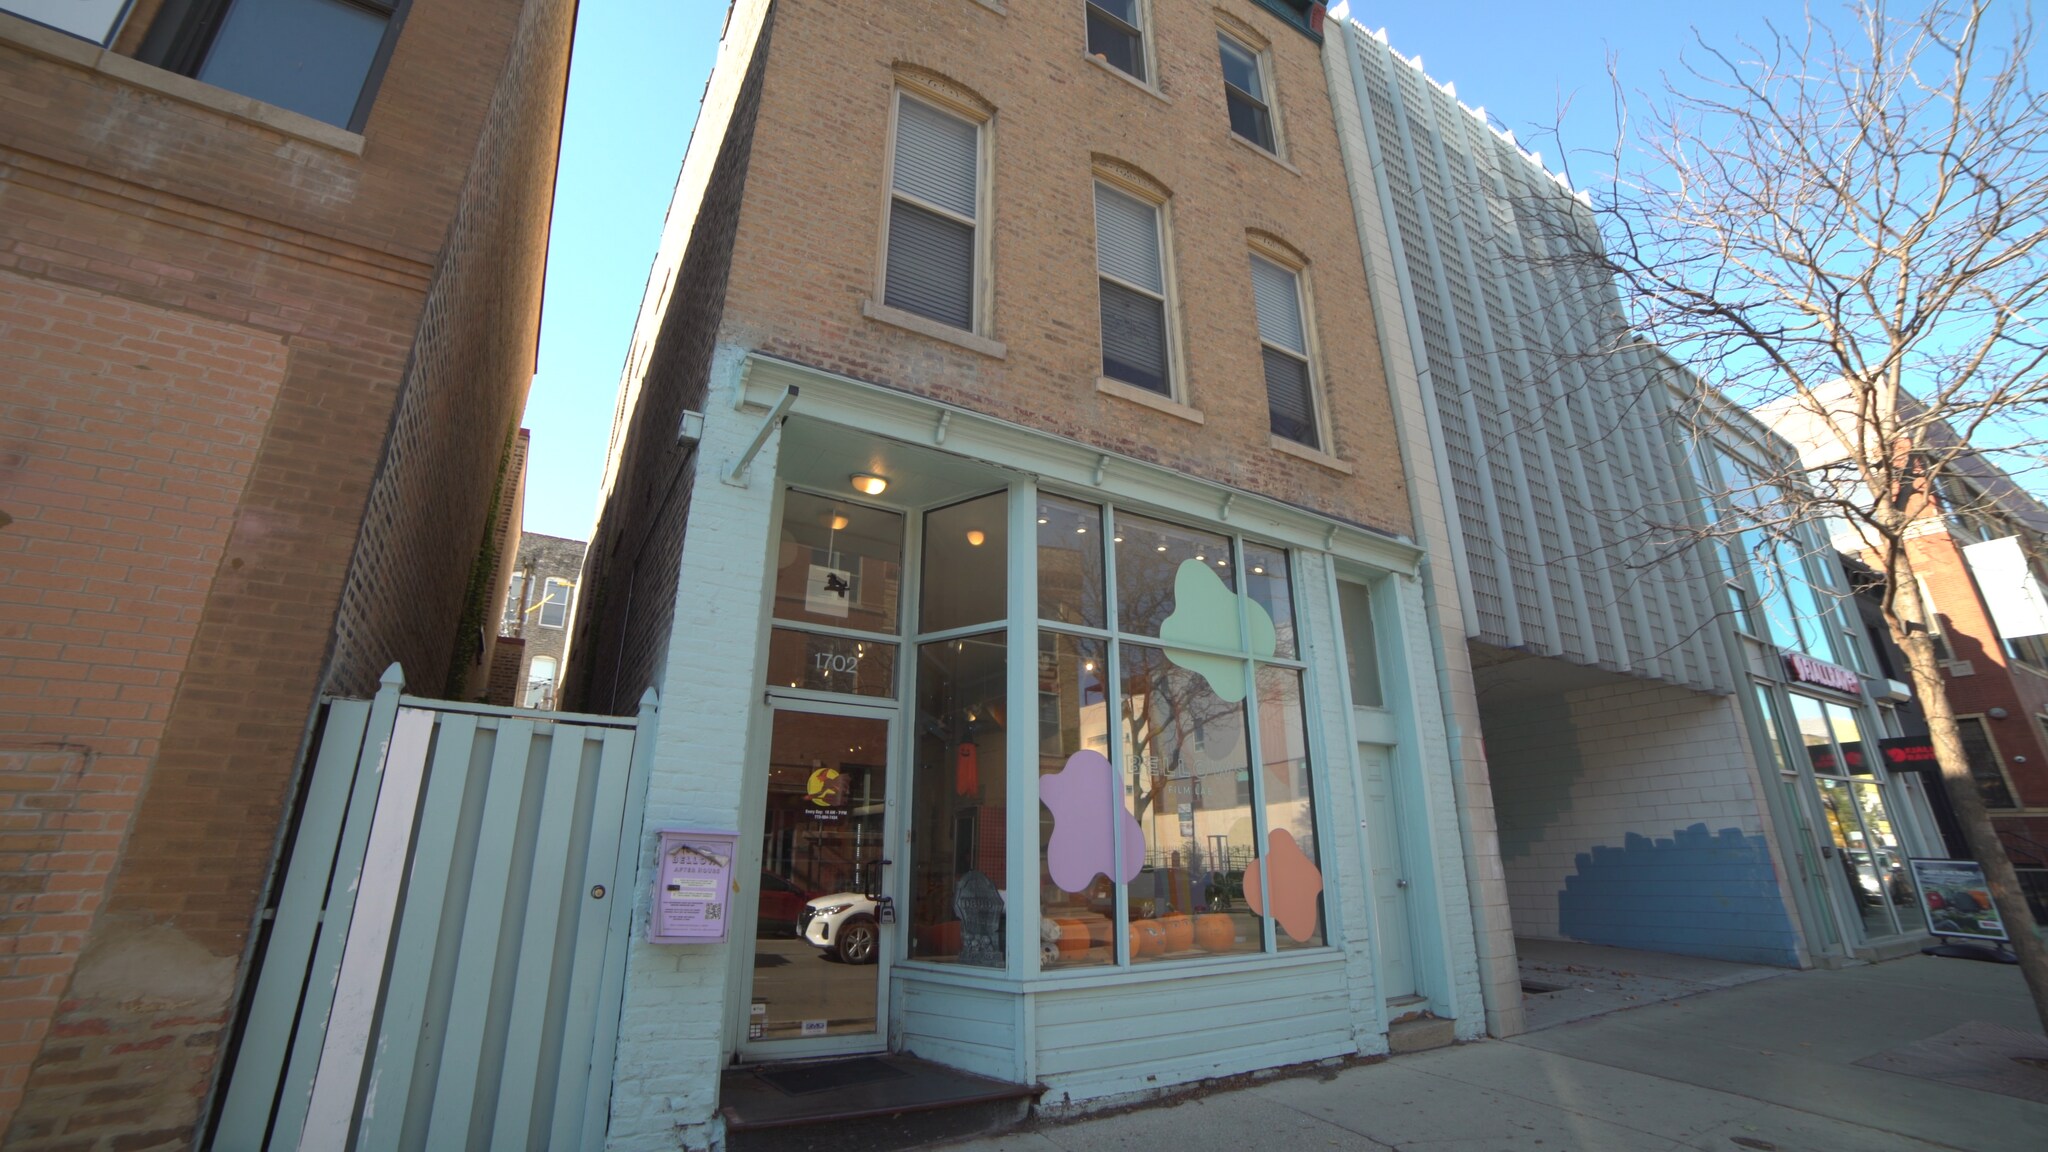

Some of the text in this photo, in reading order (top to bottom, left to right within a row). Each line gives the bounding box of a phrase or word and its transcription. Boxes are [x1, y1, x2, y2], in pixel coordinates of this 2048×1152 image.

[815, 653, 858, 674] 1702
[1168, 785, 1191, 796] FILM
[673, 856, 717, 865] BELLO
